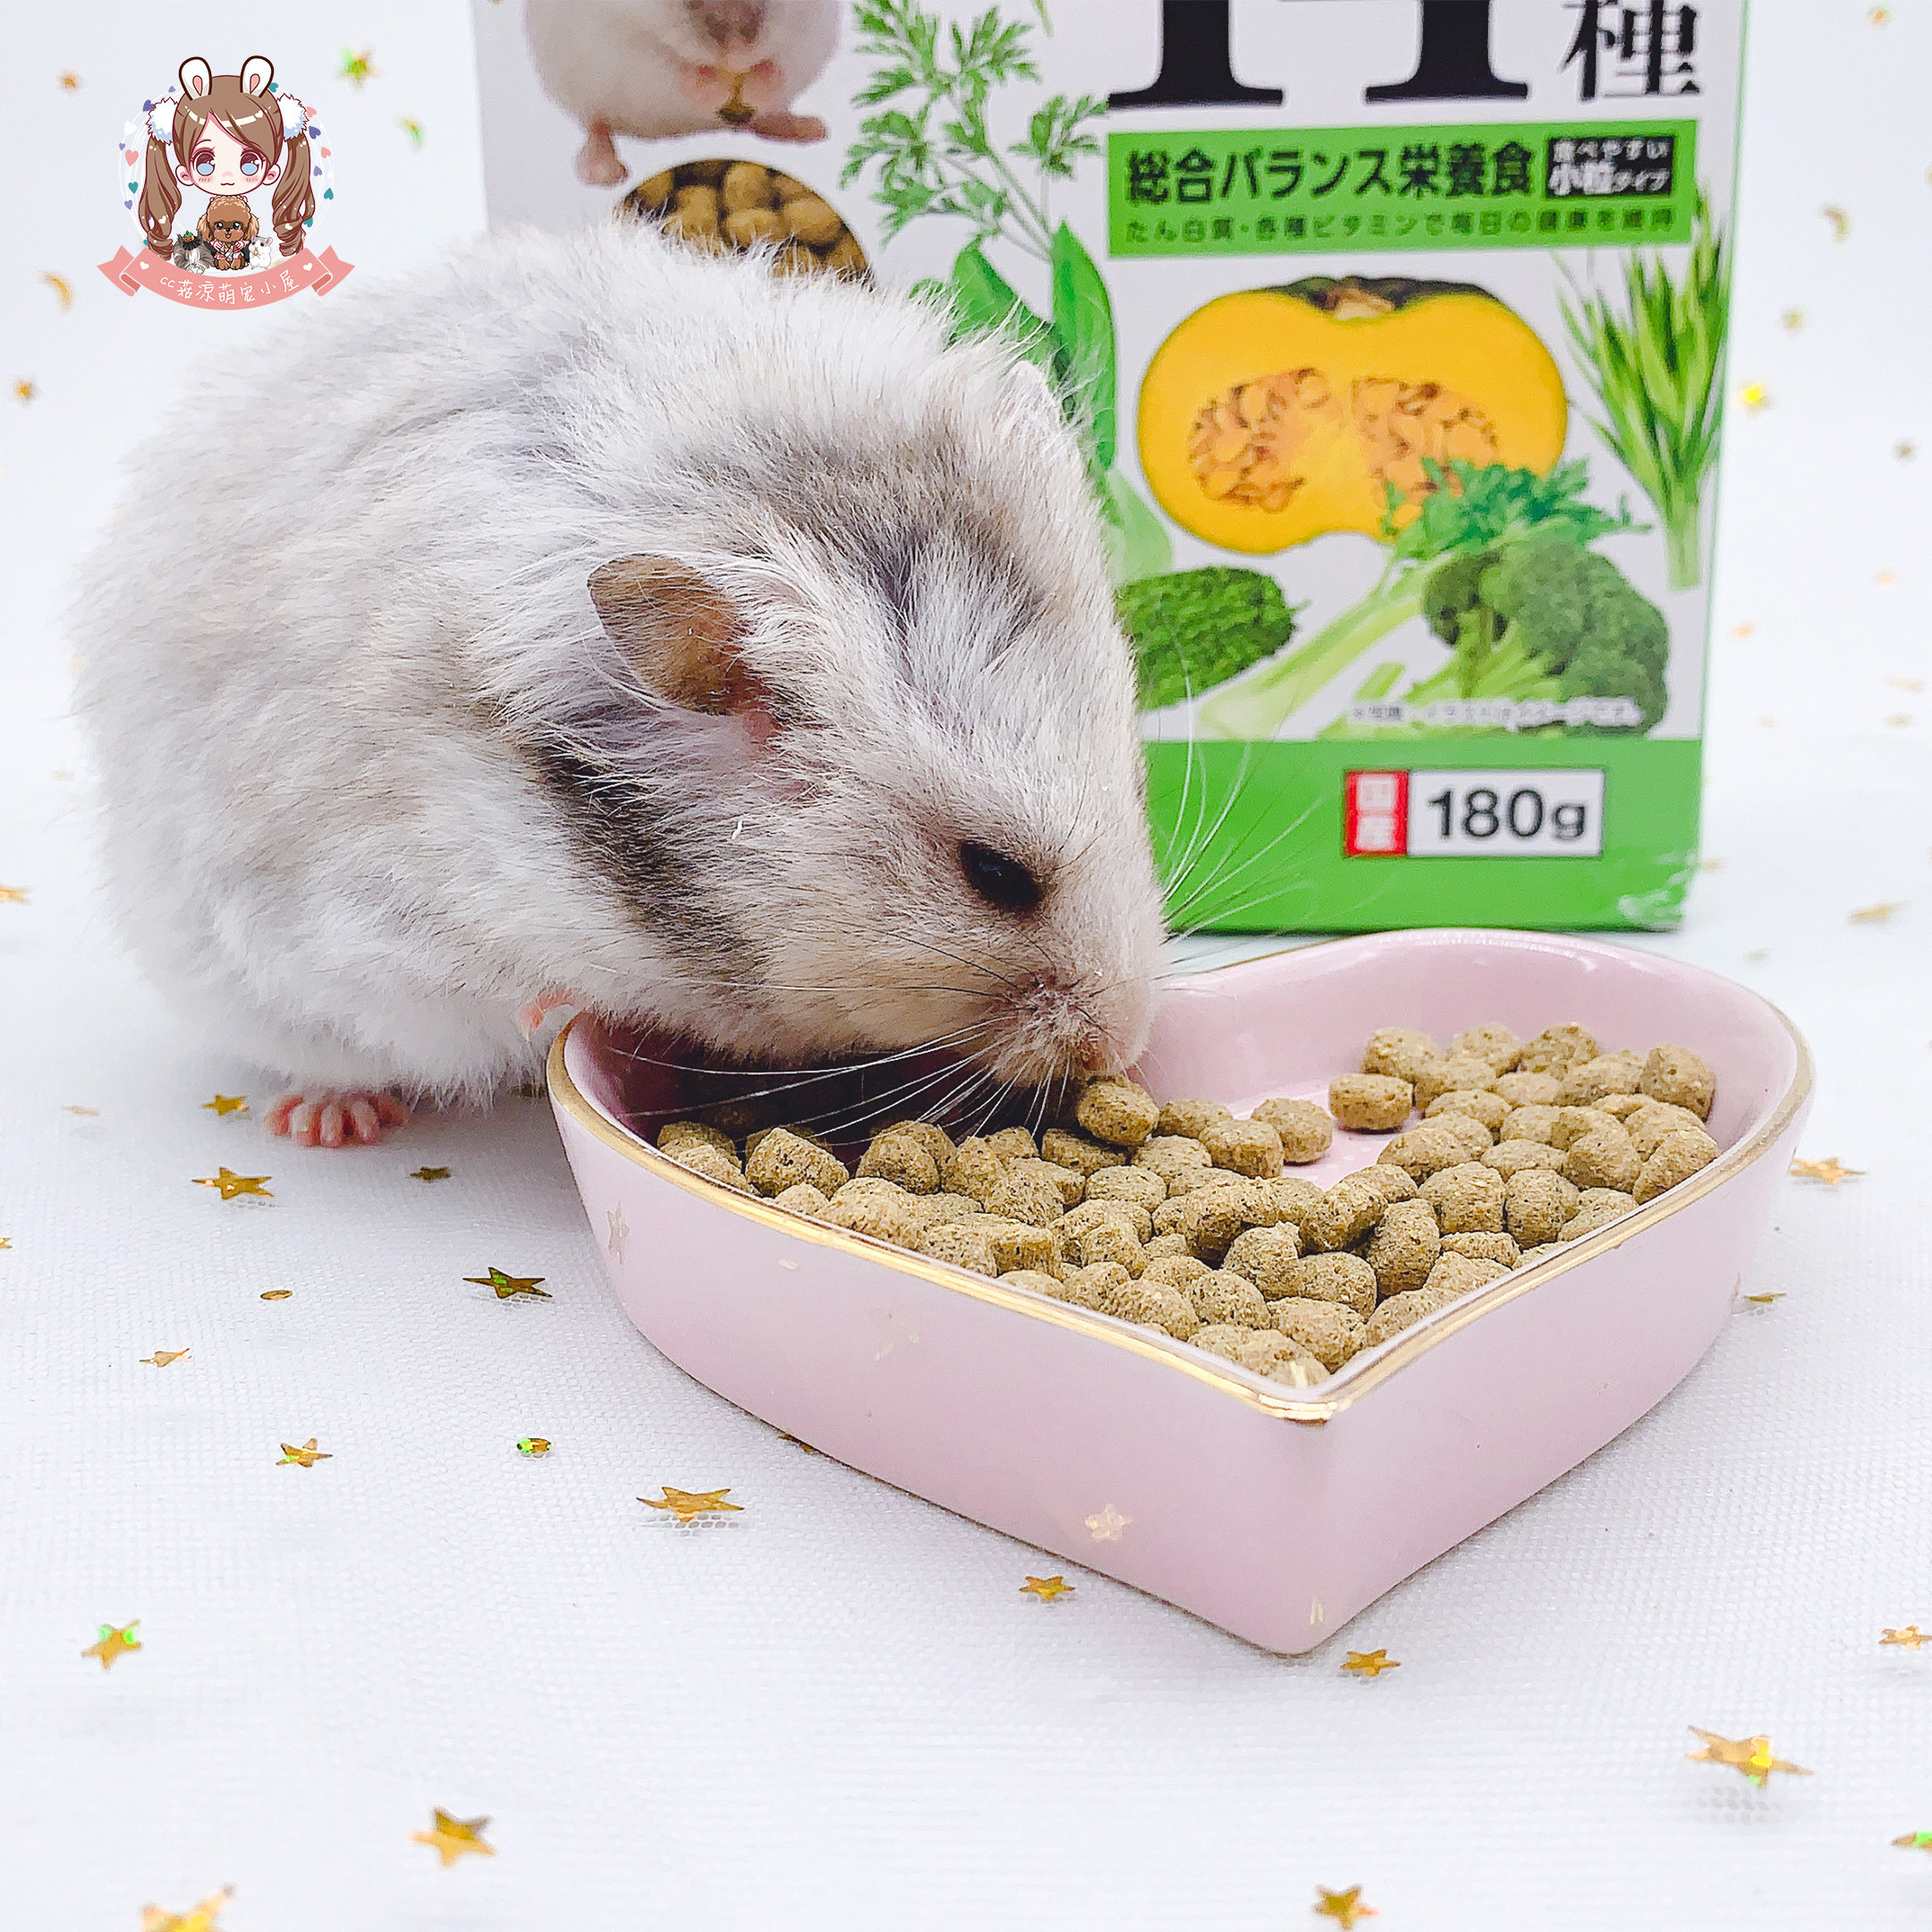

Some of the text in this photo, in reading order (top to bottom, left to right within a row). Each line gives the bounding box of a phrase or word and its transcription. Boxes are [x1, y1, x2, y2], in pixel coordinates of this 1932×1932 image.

[1127, 140, 1533, 204] 総合バランス栄養食
[1428, 789, 1587, 839] 180g
